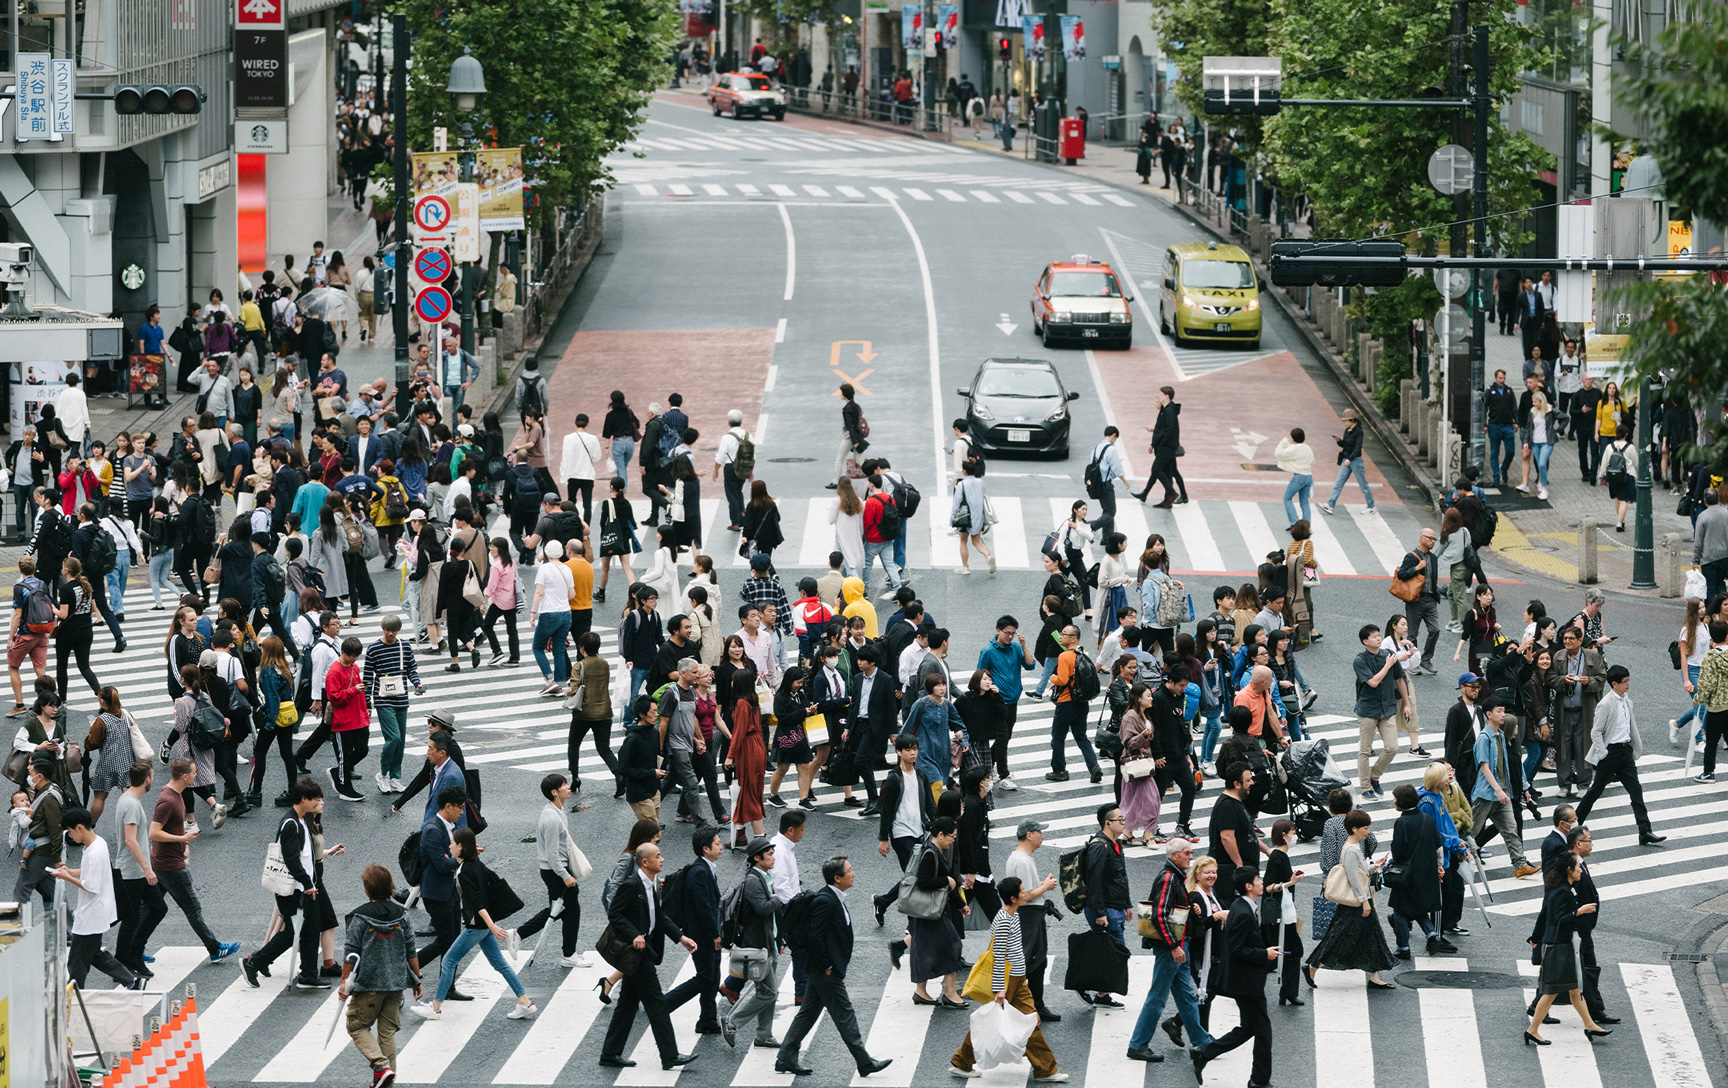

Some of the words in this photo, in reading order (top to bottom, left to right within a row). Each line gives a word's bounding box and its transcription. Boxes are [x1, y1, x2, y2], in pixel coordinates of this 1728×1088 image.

[242, 60, 279, 69] WIRED
[19, 71, 29, 104] Shibuya
[30, 60, 46, 132] 渋谷駅前
[57, 63, 70, 130] スクランブル式
[20, 107, 29, 124] Sta.
[458, 190, 470, 254] 公園通り
[1670, 226, 1692, 235] NE
